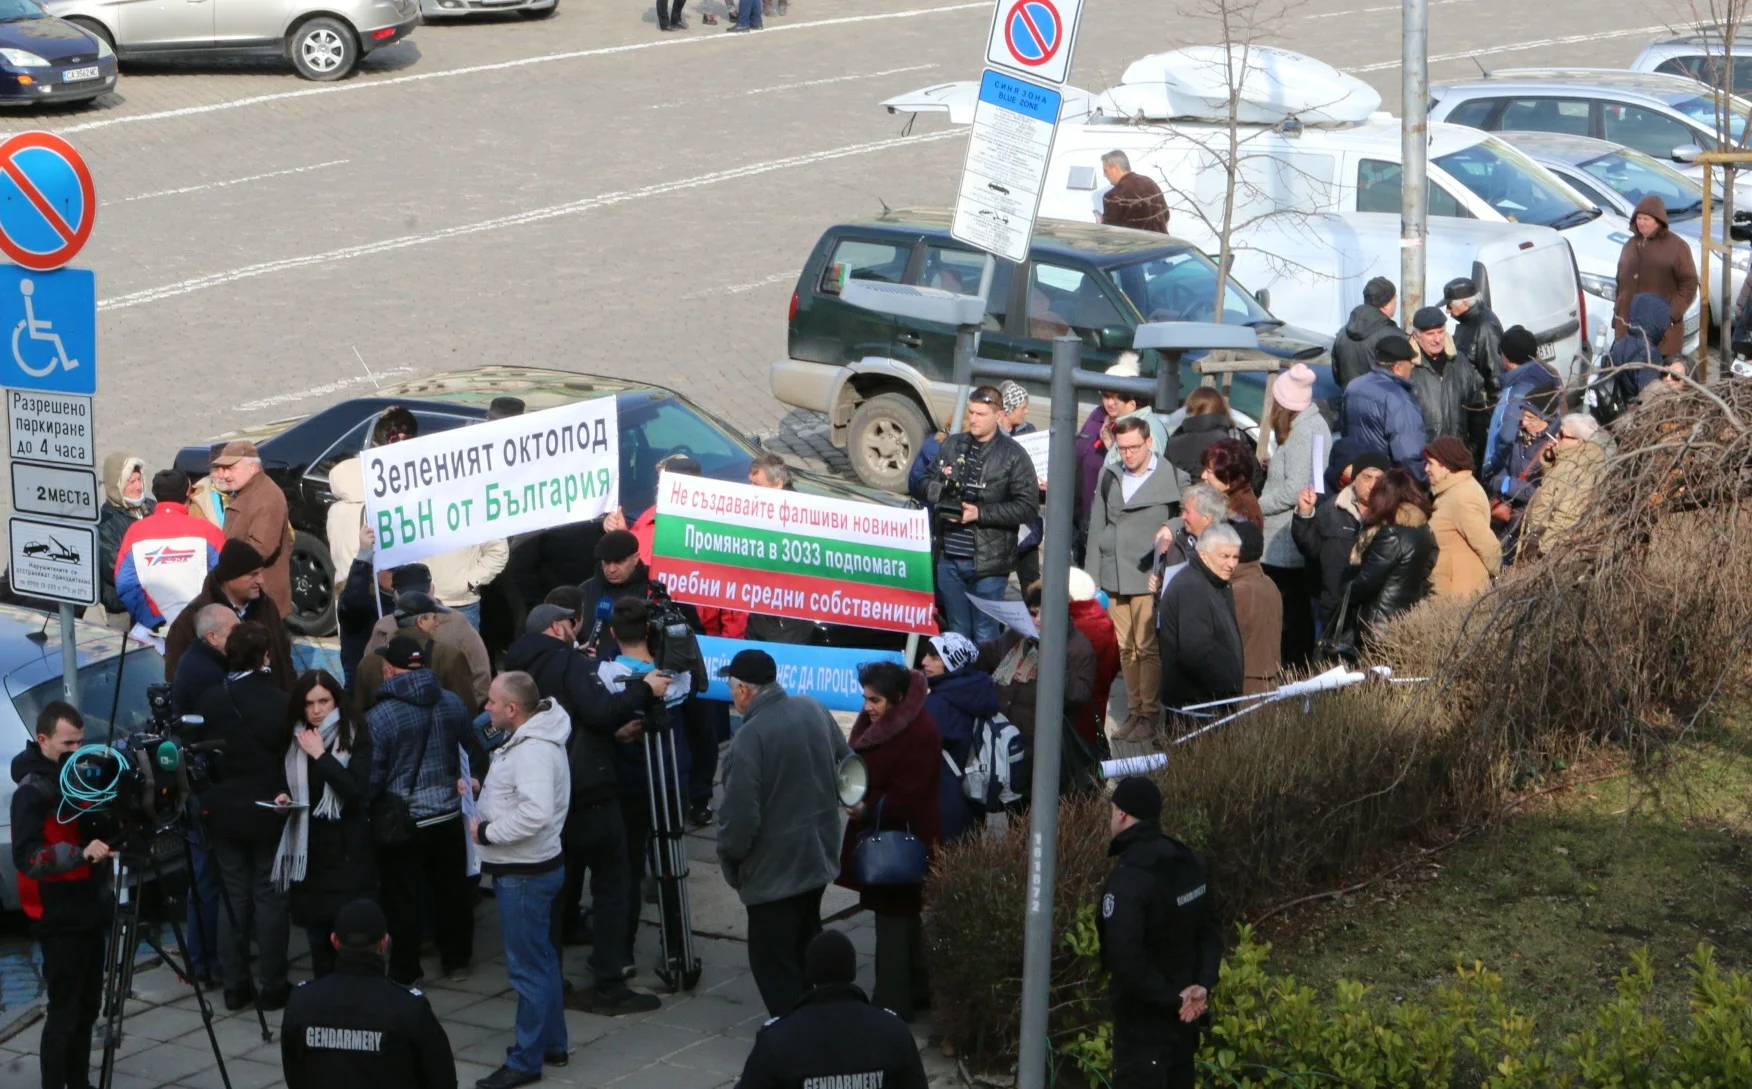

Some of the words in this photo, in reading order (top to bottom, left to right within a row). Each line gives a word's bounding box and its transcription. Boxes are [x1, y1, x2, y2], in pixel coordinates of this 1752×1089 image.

[999, 92, 1017, 104] BLUE
[1019, 99, 1039, 111] ZONE
[14, 393, 86, 417] Разрешено
[16, 418, 85, 438] паркиране
[17, 440, 32, 454] до
[40, 439, 48, 455] 4
[54, 445, 85, 459] часа
[371, 443, 494, 498] Зеленият
[503, 418, 608, 467] октопод
[377, 498, 434, 550] ВЪН
[447, 499, 473, 531] от
[485, 468, 610, 522] България
[670, 481, 688, 505] Не
[691, 490, 775, 519] създавайте
[779, 499, 848, 531] фалшиви
[853, 517, 926, 541] новини!!!
[684, 523, 764, 555] Промяната
[769, 543, 777, 560] в
[825, 550, 907, 578] подпомага
[726, 582, 736, 600] и
[741, 583, 805, 609] средни
[810, 590, 934, 628] собственици!
[798, 665, 814, 695] ДА
[817, 666, 864, 698] ПРОЦЪ
[306, 1026, 382, 1051] GENDARMERY
[803, 1070, 884, 1089] GENDARMERY
